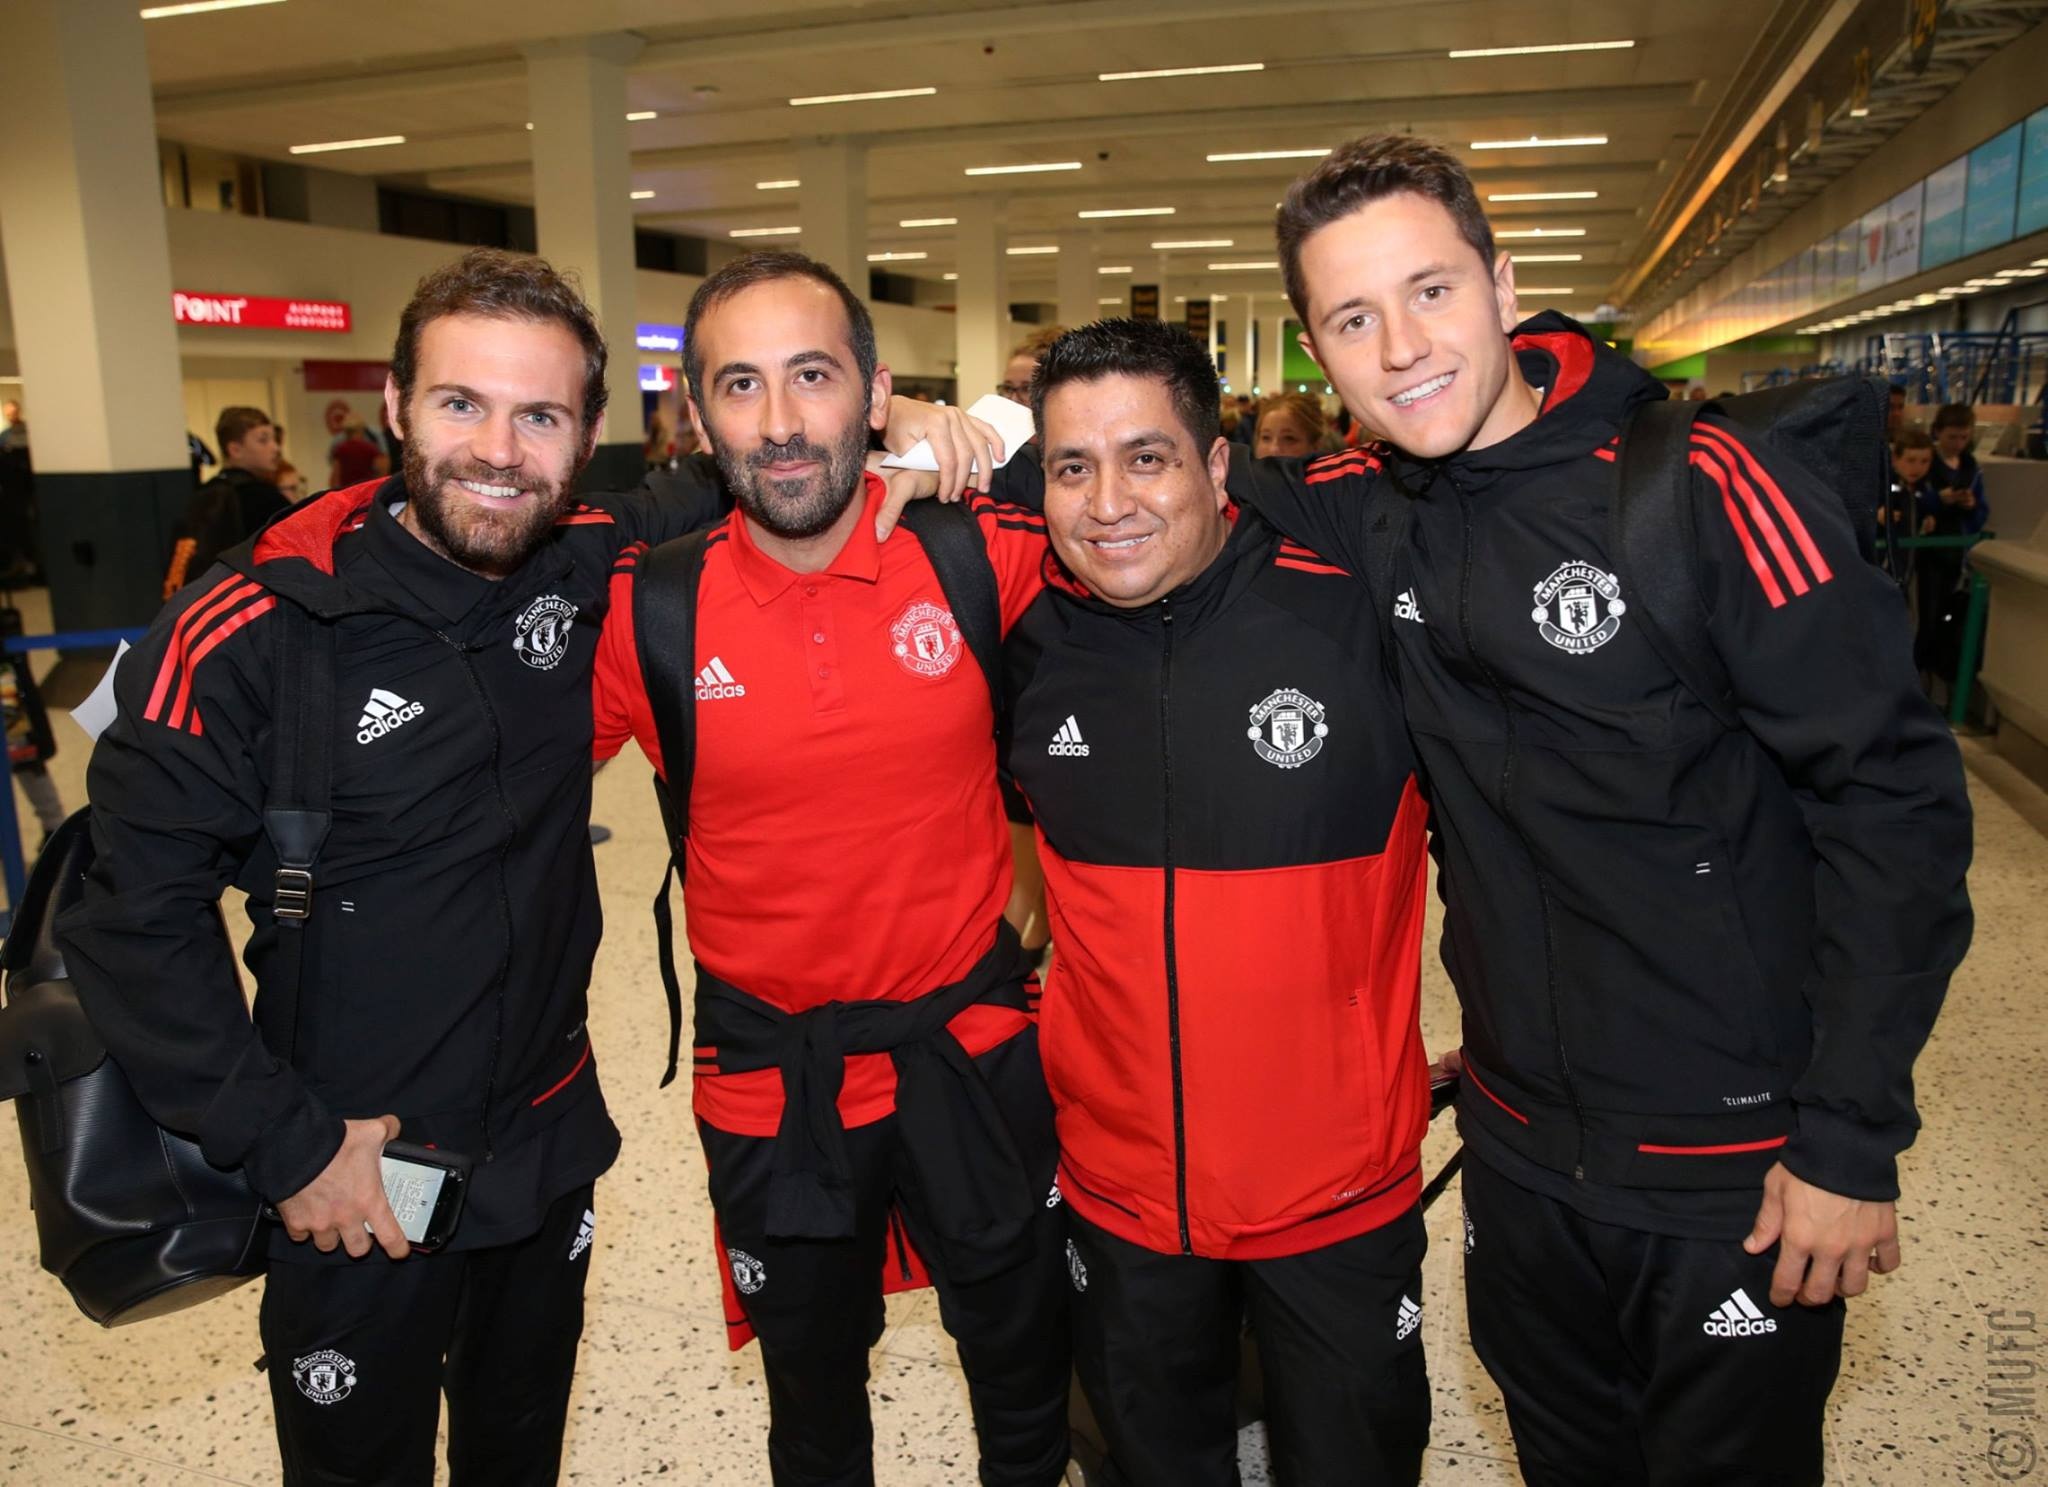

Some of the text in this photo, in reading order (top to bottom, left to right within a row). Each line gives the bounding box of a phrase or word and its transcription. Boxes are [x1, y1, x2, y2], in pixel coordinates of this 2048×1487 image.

[1541, 567, 1613, 601] MANCHESTER
[521, 601, 572, 631] MANCHESTER
[899, 608, 952, 637] MANCHESTER
[1554, 629, 1608, 648] UNITED
[531, 645, 563, 665] UNITED
[916, 654, 953, 671] UNITED
[1255, 692, 1319, 720] MANCHESTER
[356, 700, 425, 745] adidas
[1048, 741, 1090, 757] adidas
[1266, 748, 1313, 763] UNITED
[1725, 1091, 1771, 1106] CLIMALITE
[1703, 1317, 1778, 1337] adidas
[298, 1353, 350, 1372] MANCHESTER
[305, 1387, 341, 1400] UNITED
